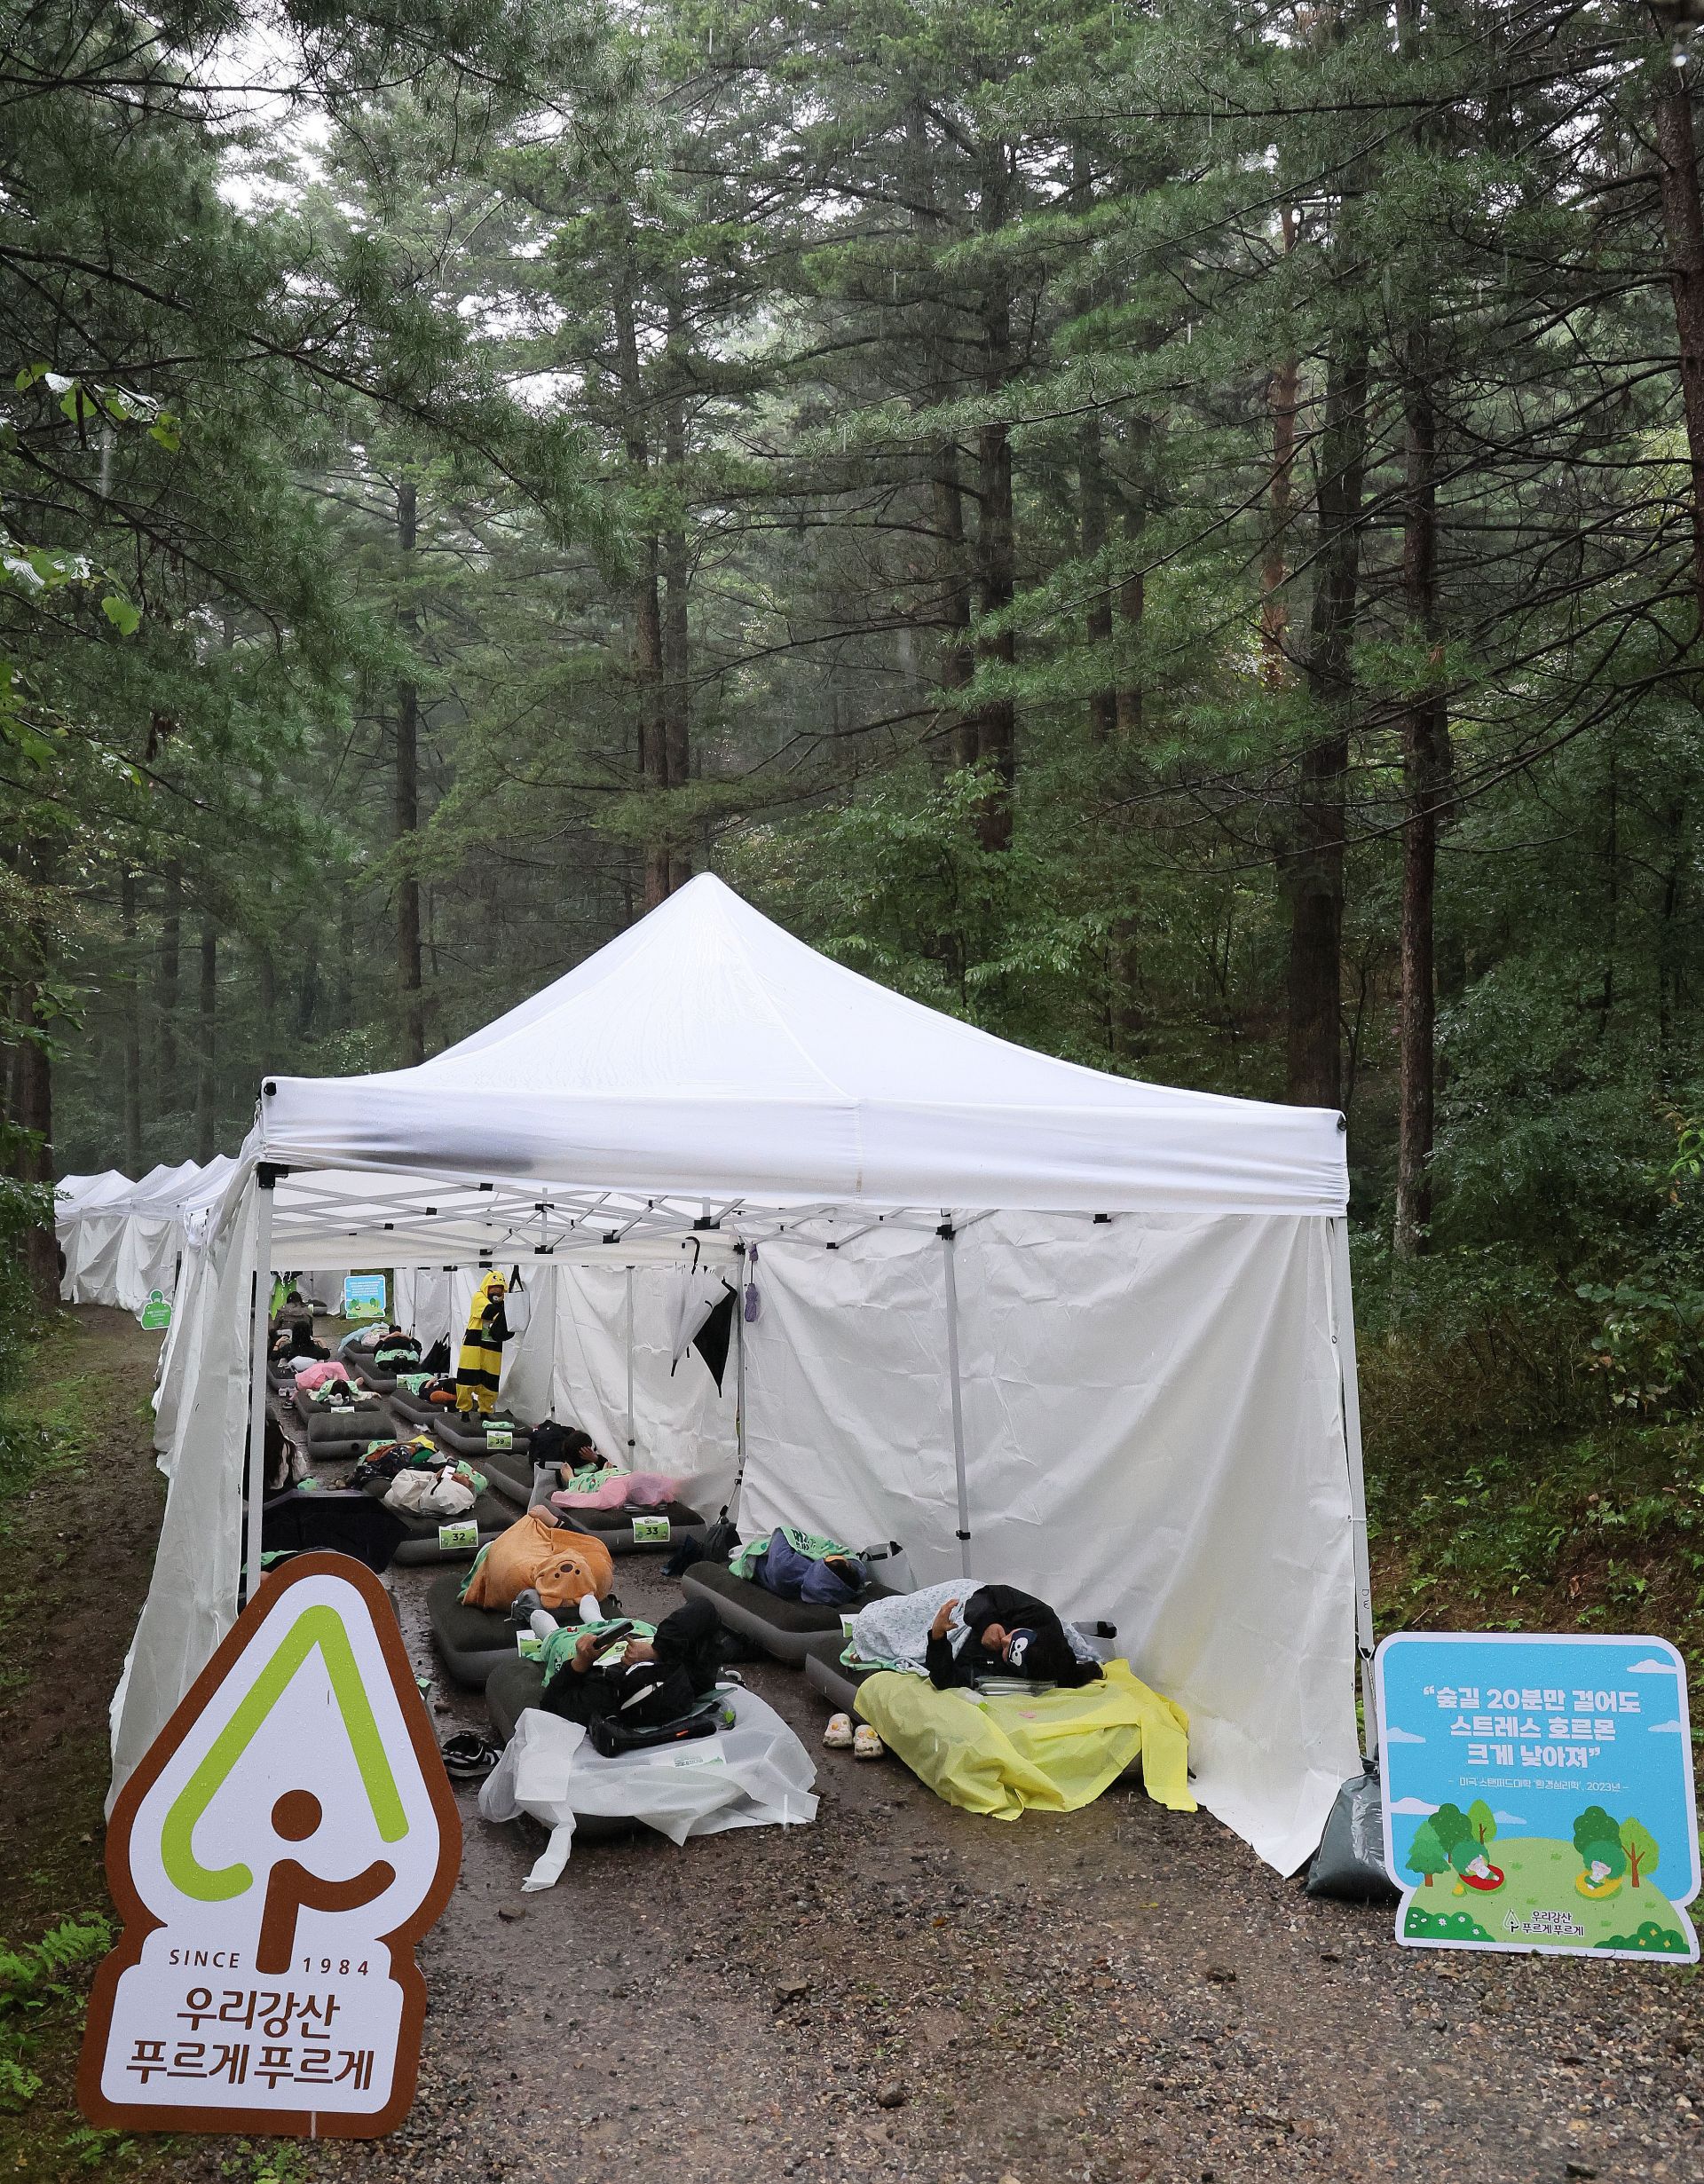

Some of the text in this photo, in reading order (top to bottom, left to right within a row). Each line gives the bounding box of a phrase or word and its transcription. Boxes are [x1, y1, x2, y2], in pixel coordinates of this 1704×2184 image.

[452, 1533, 466, 1541] 32
[645, 1526, 659, 1535] 33
[1424, 1684, 1642, 1714] “숲길 20분만 걸어도
[1449, 1715, 1616, 1741] 스트레스 호르몬
[1467, 1743, 1601, 1769] 크게 낮아져”
[1531, 1910, 1573, 1924] 우리강산
[168, 1949, 370, 1976] SINCE 1984
[176, 1987, 341, 2040] 우리강산
